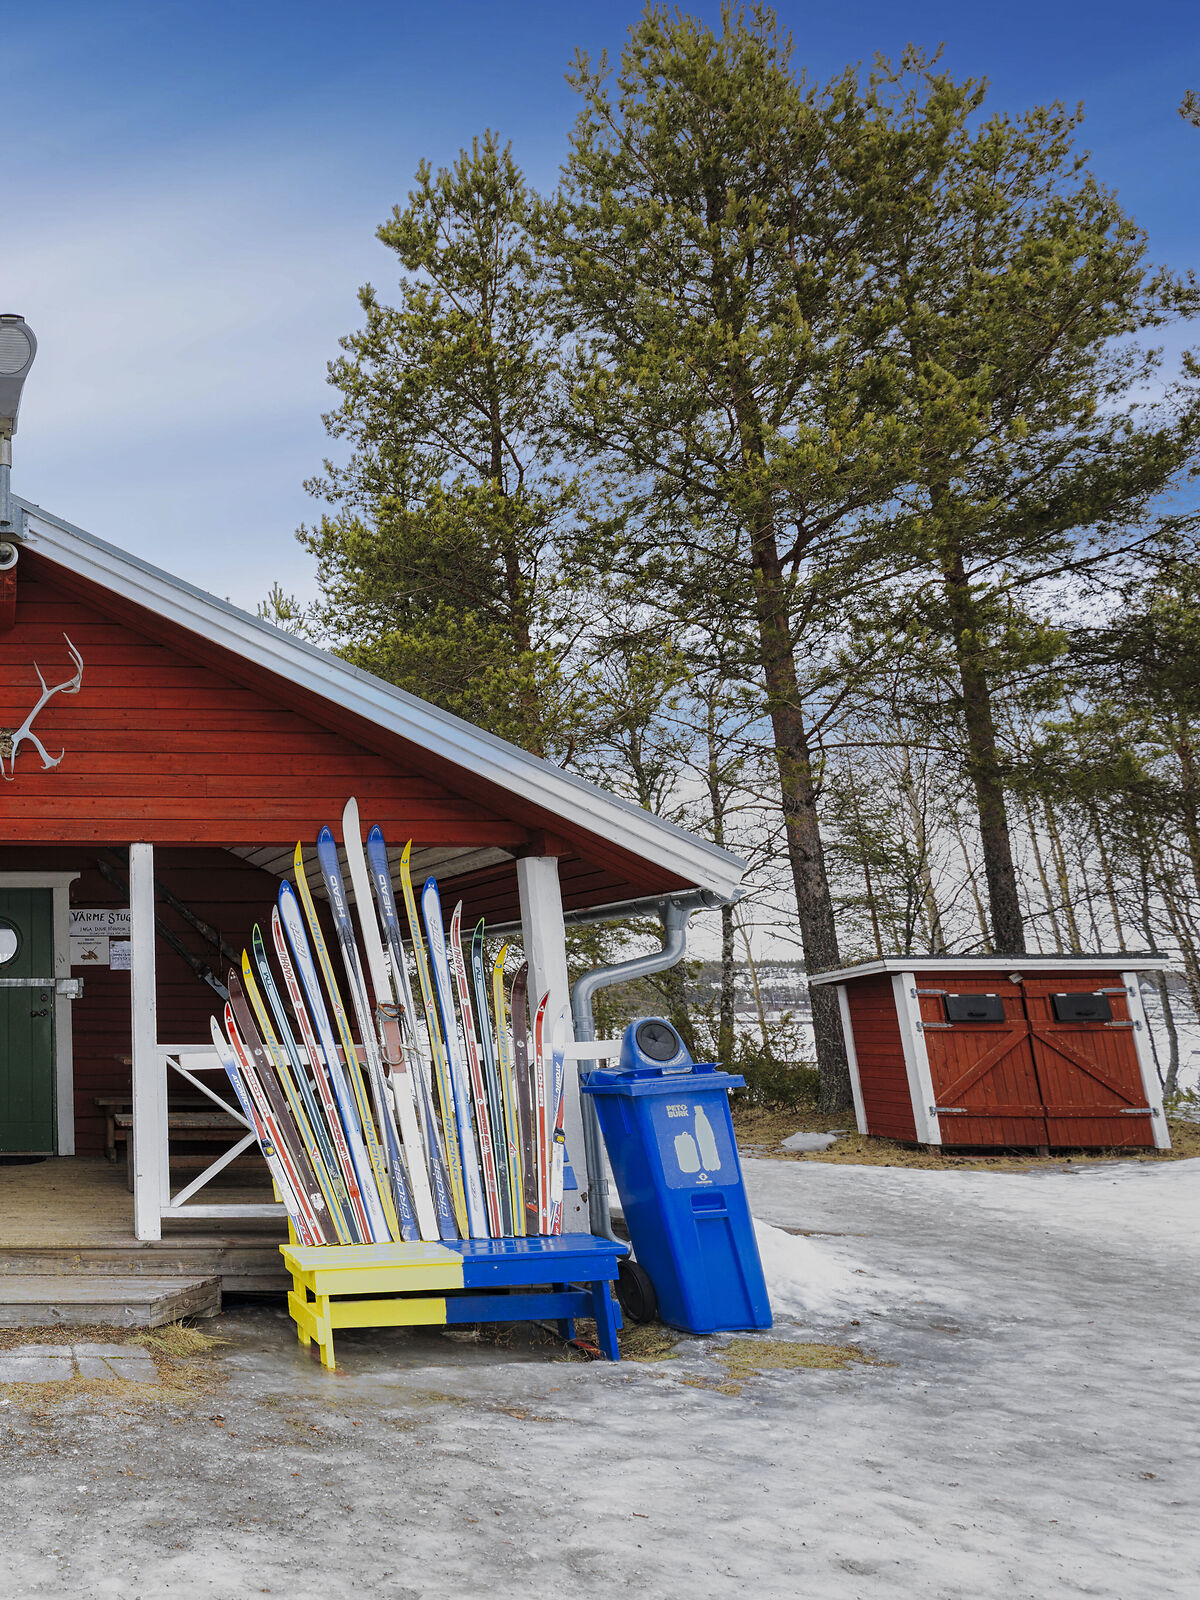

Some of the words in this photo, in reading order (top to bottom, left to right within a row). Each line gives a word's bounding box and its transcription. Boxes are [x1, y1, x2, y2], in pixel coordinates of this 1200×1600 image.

[72, 911, 104, 921] VÄRME
[330, 875, 345, 917] HEAD
[379, 874, 393, 917] HEAD
[280, 953, 294, 980] KARHU
[454, 948, 464, 976] KARHU
[232, 1073, 248, 1106] ATOMIC
[536, 1054, 544, 1107] FISCHER
[365, 1120, 384, 1183] RACING
[445, 1117, 458, 1180] RACING
[393, 1159, 410, 1219] CROSS
[432, 1157, 448, 1217] CROSS
